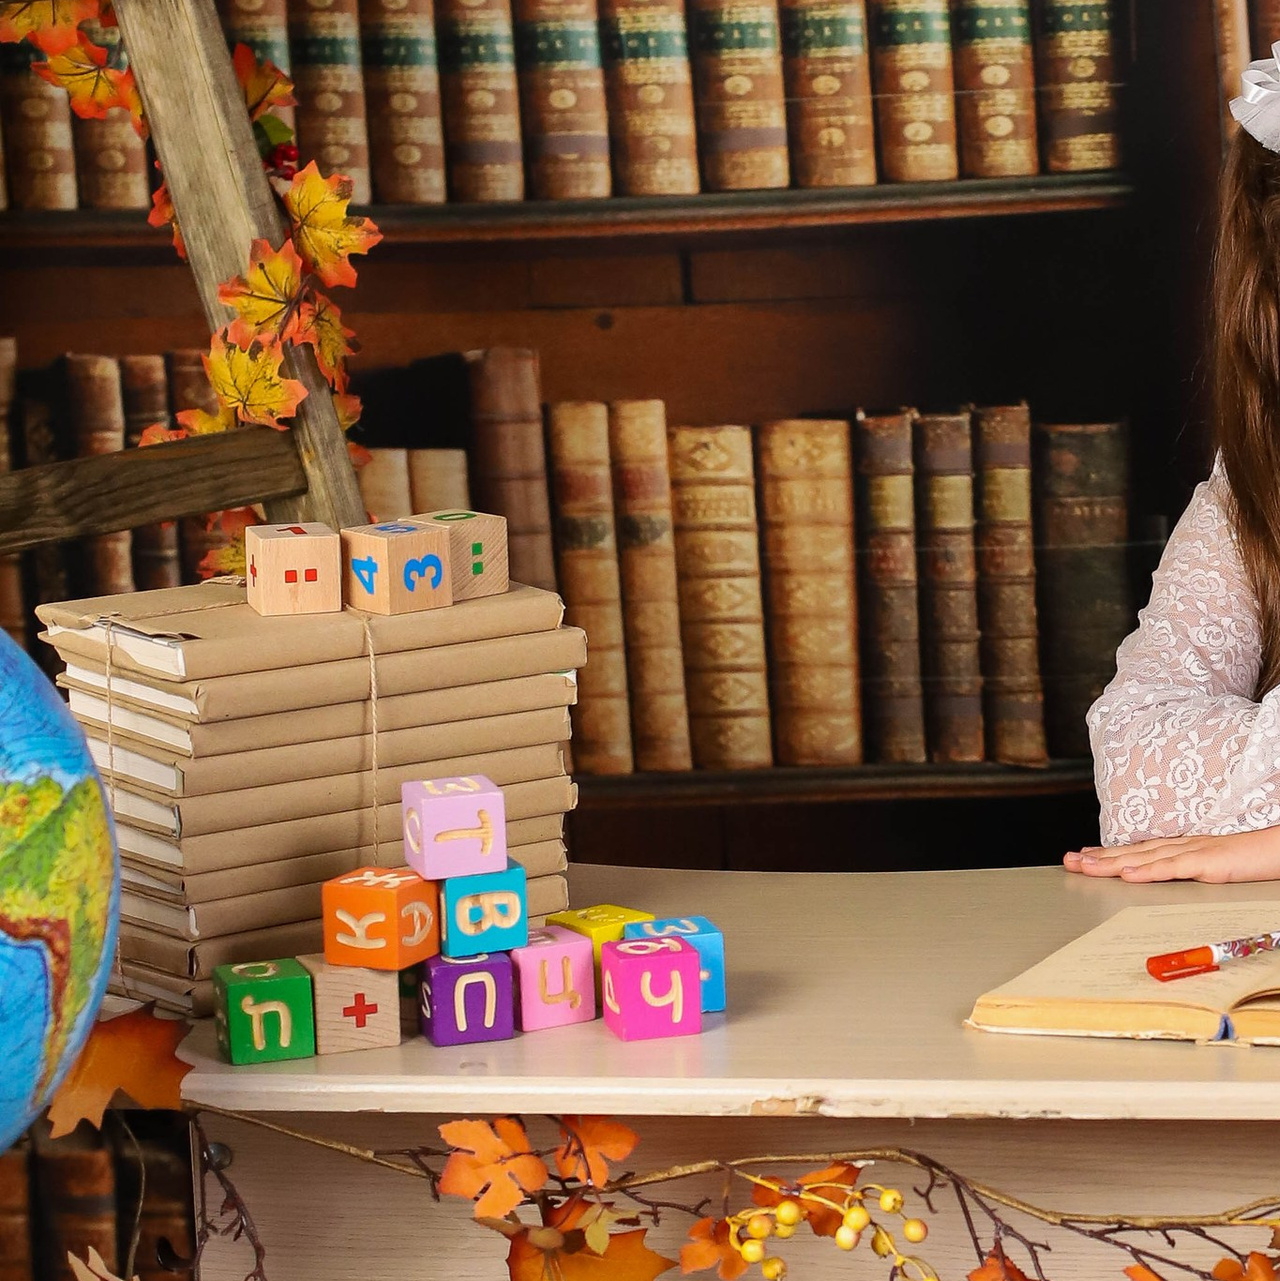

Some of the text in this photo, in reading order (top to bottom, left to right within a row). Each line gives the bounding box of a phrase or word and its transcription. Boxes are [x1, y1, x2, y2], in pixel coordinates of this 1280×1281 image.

[351, 555, 378, 595] 4
[403, 553, 442, 592] 3
[335, 908, 387, 950] К
